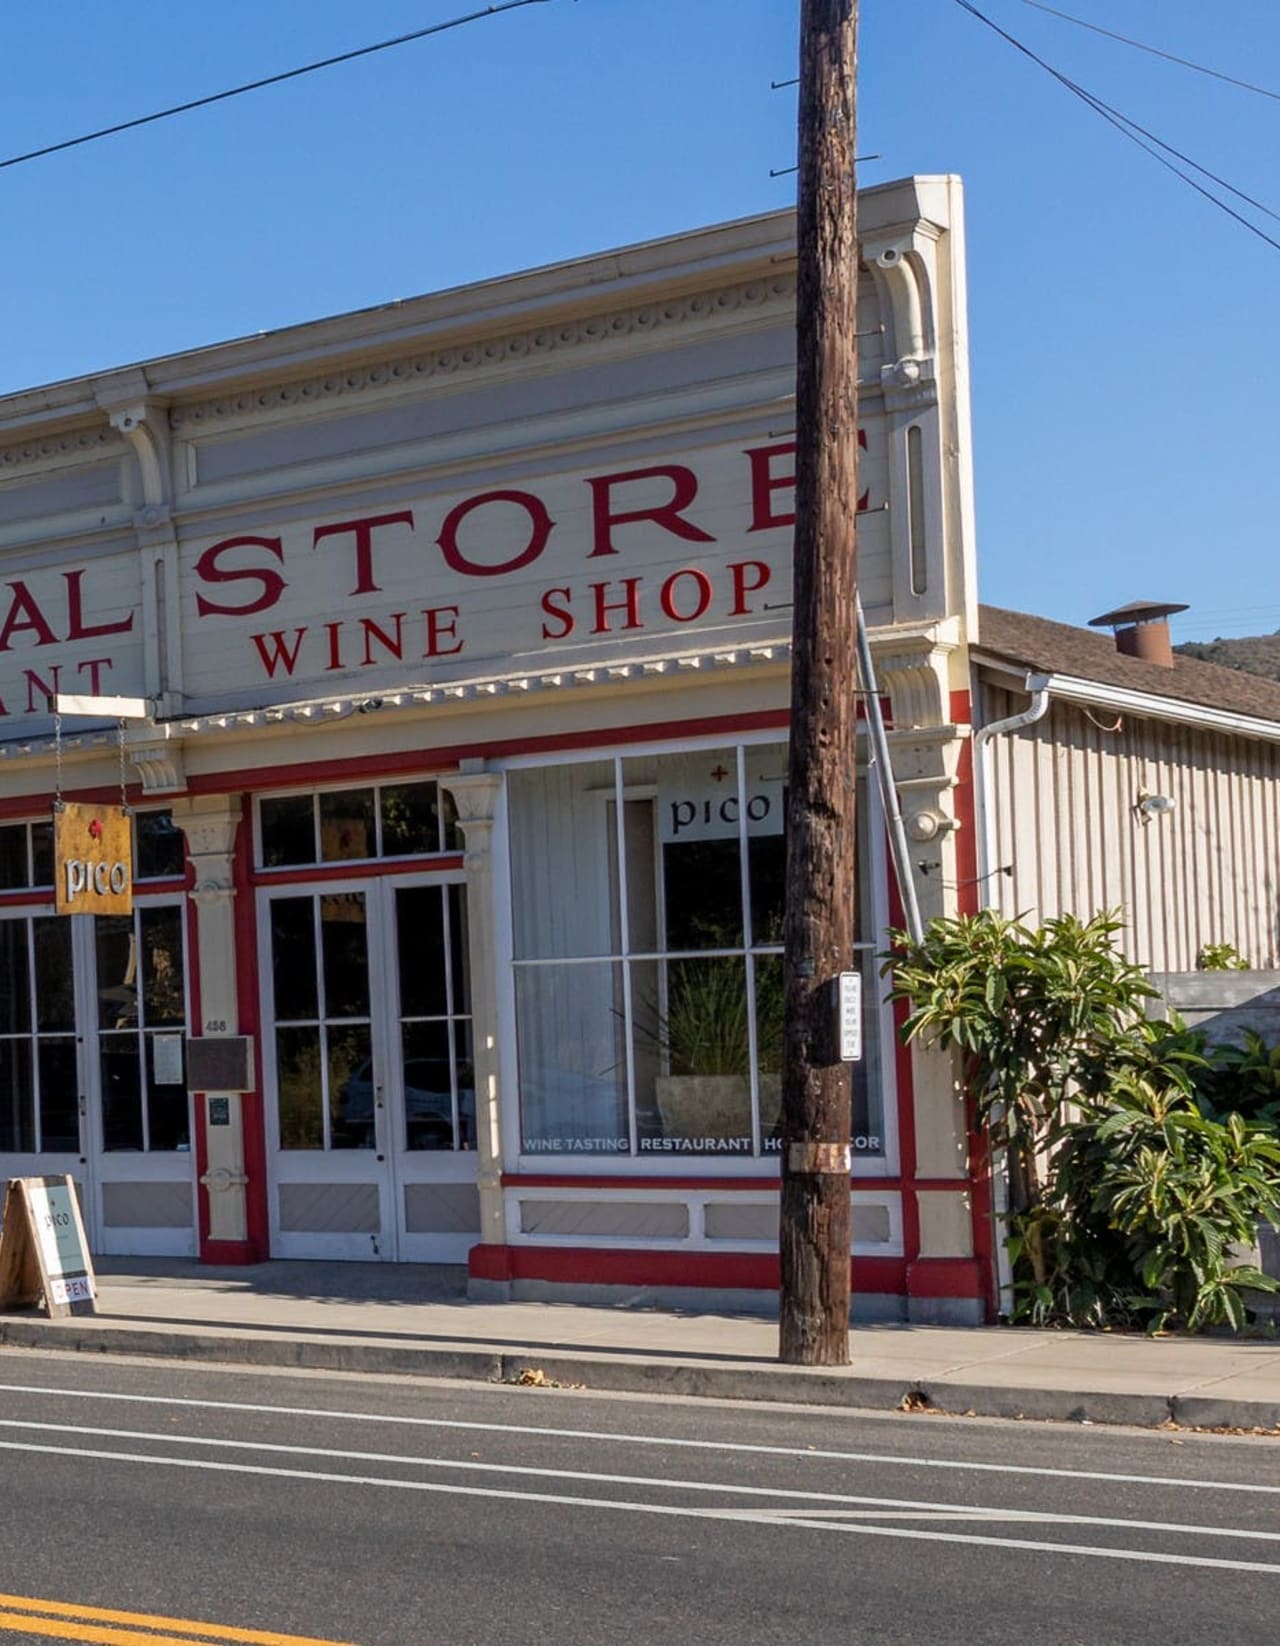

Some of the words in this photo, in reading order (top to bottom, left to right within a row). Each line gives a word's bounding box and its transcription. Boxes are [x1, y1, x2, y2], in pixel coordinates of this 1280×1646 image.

[250, 606, 465, 679] WINE
[541, 560, 772, 640] SHOP
[671, 795, 771, 835] pico
[65, 857, 127, 904] pico
[524, 1138, 562, 1151] WINE
[565, 1138, 629, 1151] TASTING
[640, 1137, 752, 1150] RESTAURANT
